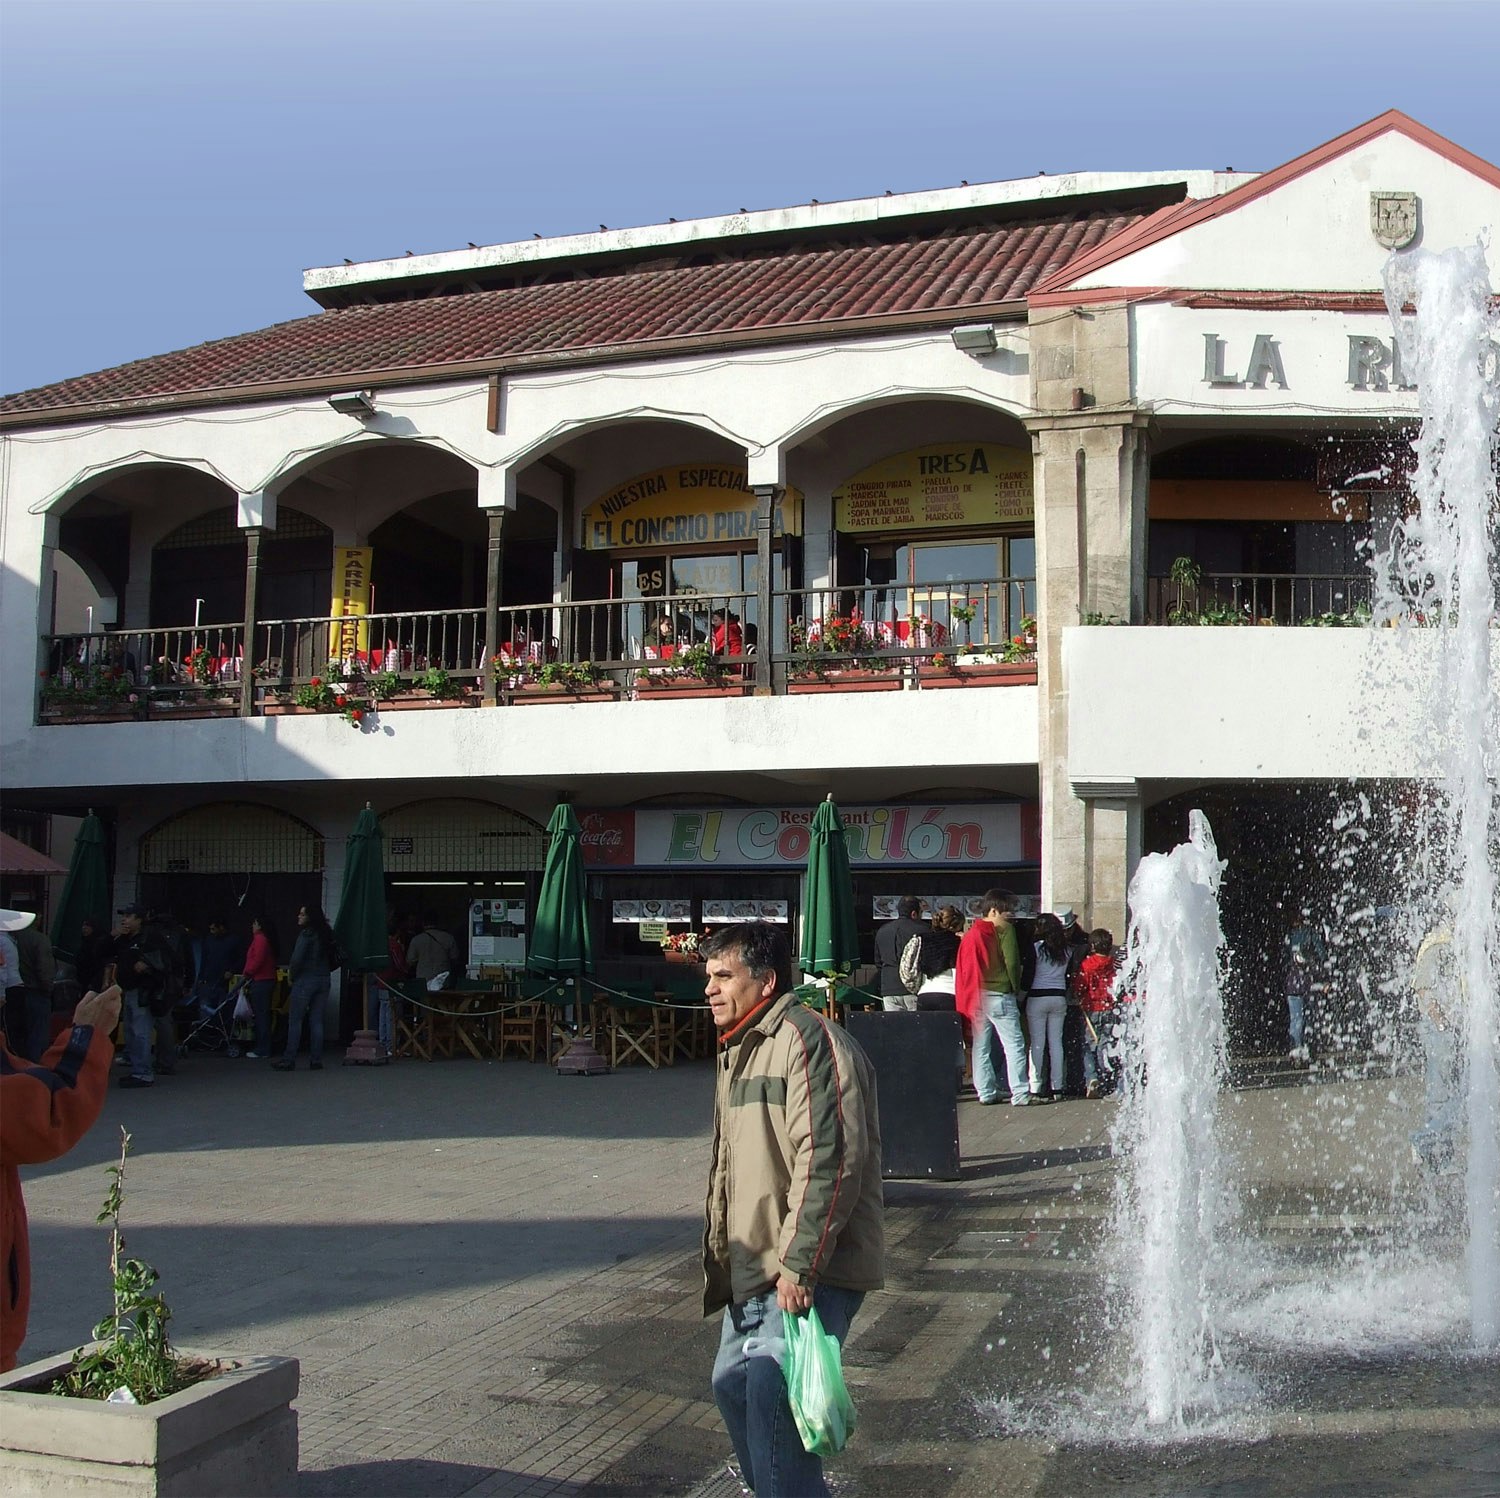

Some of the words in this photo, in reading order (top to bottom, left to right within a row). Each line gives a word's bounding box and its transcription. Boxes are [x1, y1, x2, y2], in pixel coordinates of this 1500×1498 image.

[1201, 334, 1285, 385] LA
[918, 452, 967, 475] TRES
[600, 475, 668, 518] NUESTRA
[851, 508, 870, 518] SOPA
[593, 520, 618, 548] EL
[621, 513, 708, 545] CONGRIO
[713, 508, 785, 540] PIRAA
[851, 517, 879, 526] PASTEL
[664, 811, 723, 863] El
